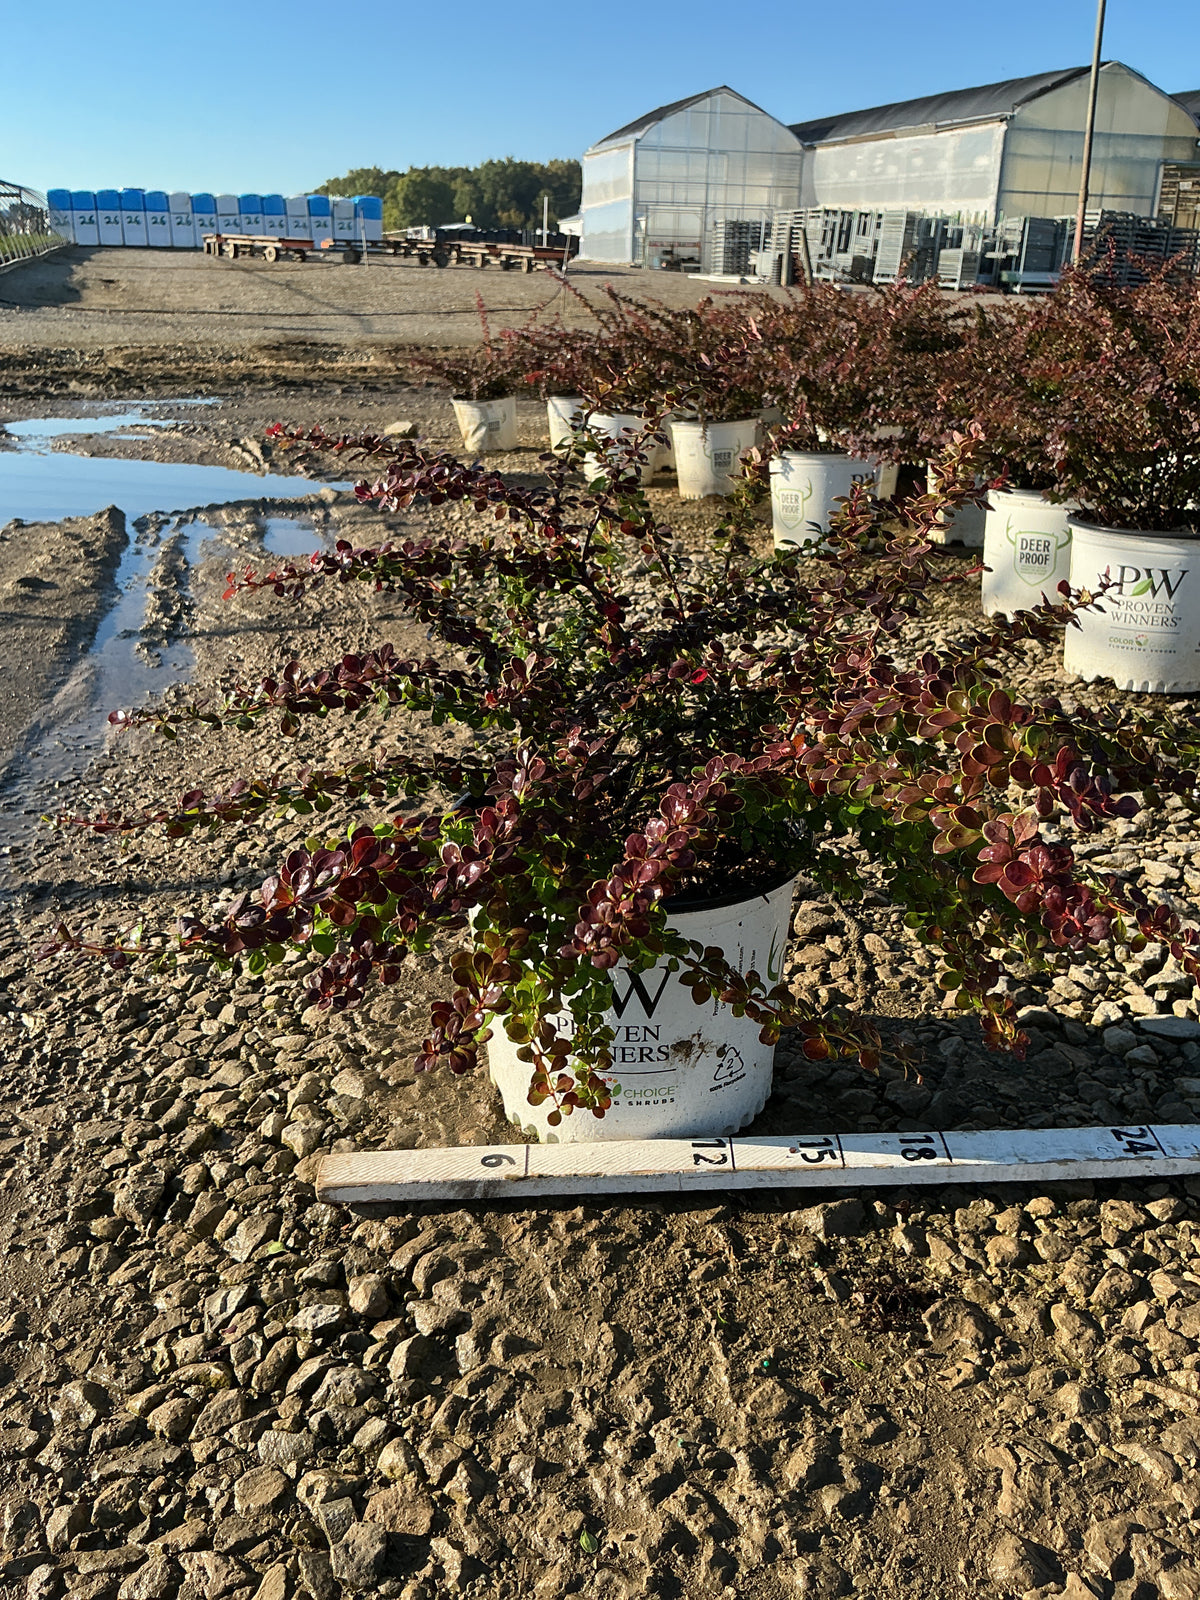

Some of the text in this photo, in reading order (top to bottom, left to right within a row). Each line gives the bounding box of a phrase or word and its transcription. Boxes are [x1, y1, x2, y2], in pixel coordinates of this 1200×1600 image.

[79, 215, 95, 225] 26
[104, 216, 119, 225] 26
[126, 215, 141, 225] 26
[151, 215, 166, 225] 26
[199, 217, 215, 228] 26
[244, 216, 260, 225] 26
[268, 220, 284, 229] 26
[781, 493, 800, 504] DEER
[782, 504, 800, 514] PROOF
[1020, 538, 1051, 552] DEER
[1019, 552, 1050, 565] PROOF
[1116, 564, 1189, 600] PW
[1117, 601, 1176, 614] PROVEN
[1109, 636, 1133, 645] COLOR
[727, 1058, 734, 1070] 2
[623, 1086, 676, 1099] CHOICE
[628, 1097, 675, 1106] SHRUBS
[1111, 1127, 1151, 1156] 24
[691, 1138, 728, 1165] 12
[800, 1137, 837, 1164] 15
[899, 1134, 937, 1162] 18
[481, 1153, 516, 1168] 6
